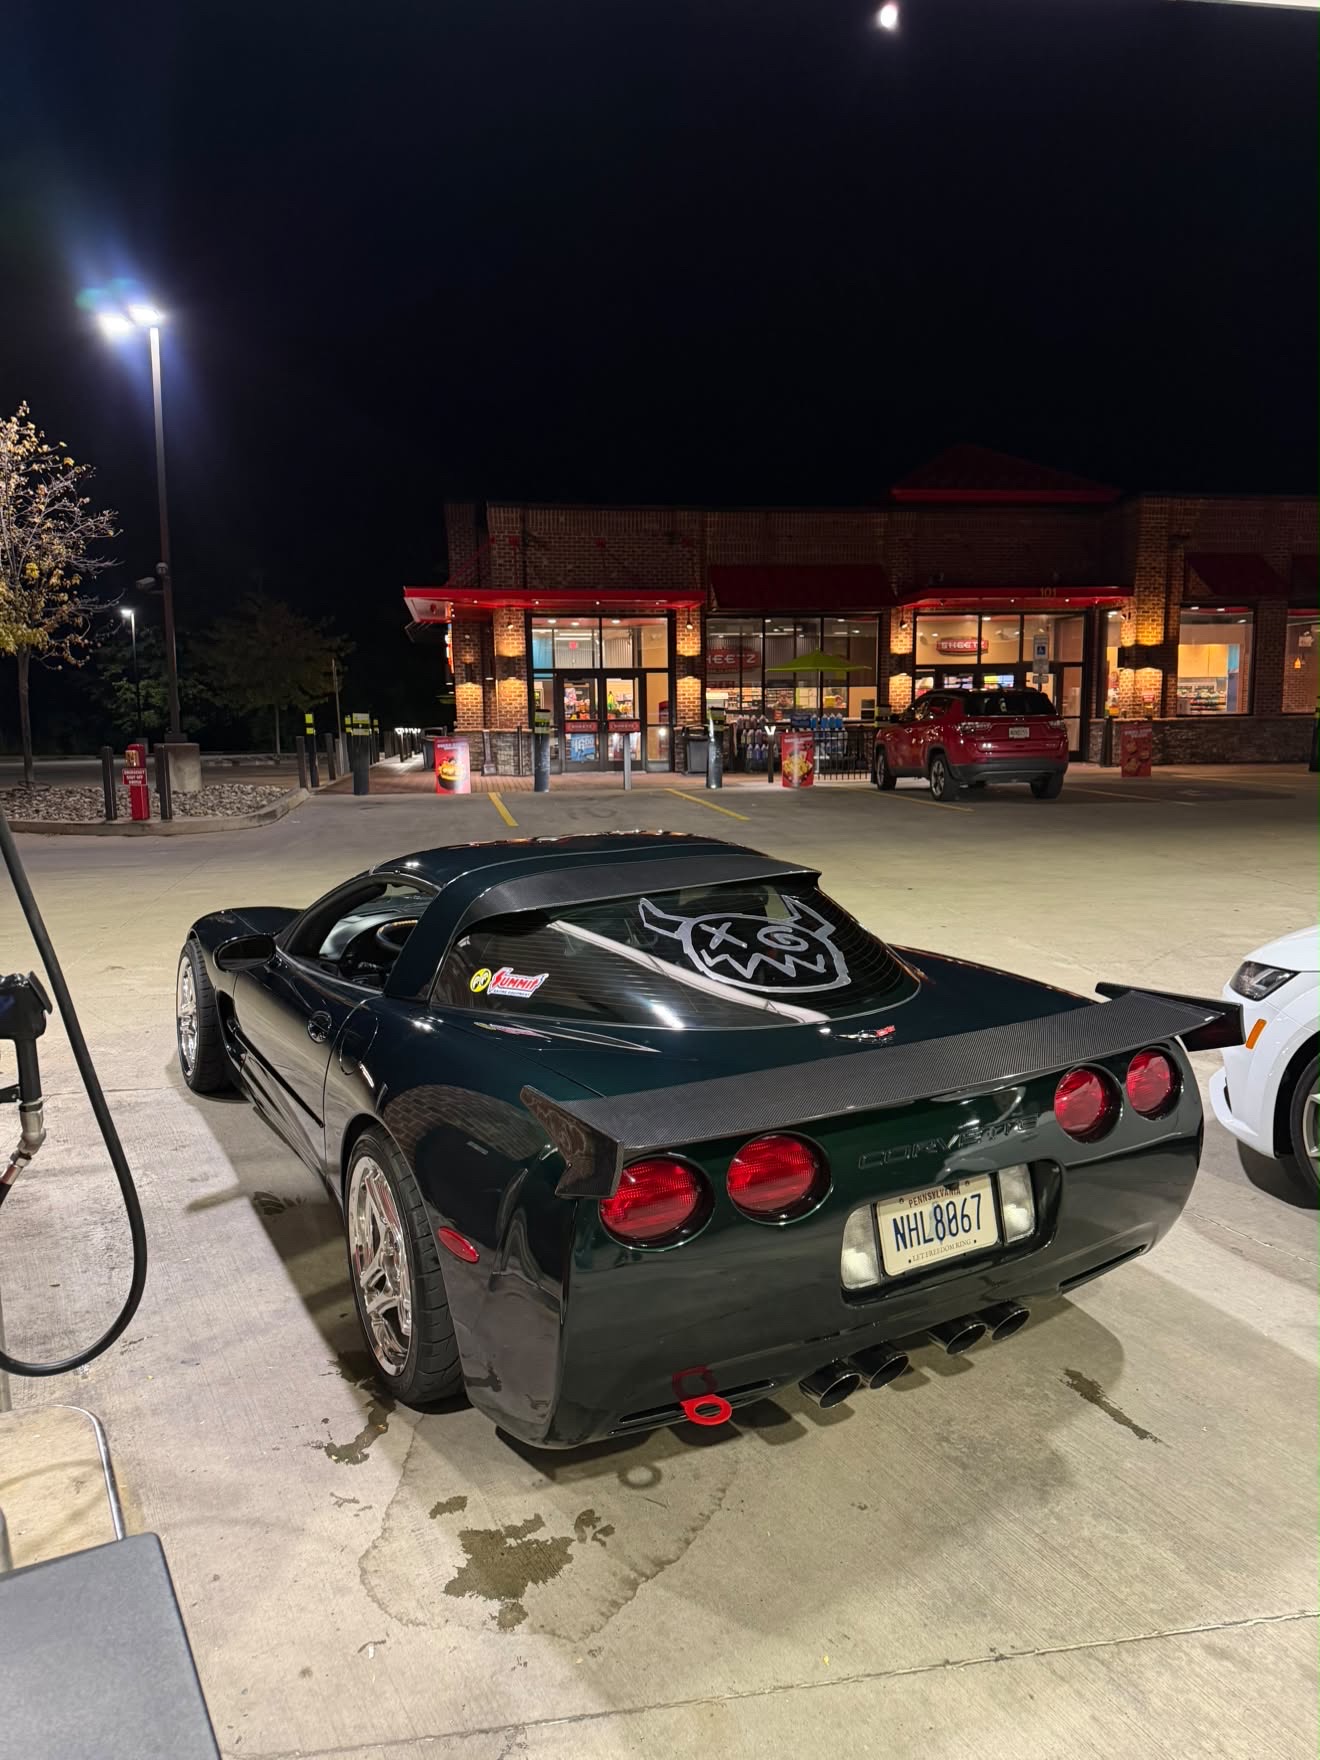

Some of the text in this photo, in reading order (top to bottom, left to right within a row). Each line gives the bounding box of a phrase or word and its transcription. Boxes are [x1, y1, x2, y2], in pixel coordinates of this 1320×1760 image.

[1040, 587, 1056, 597] 101
[492, 970, 539, 989] SUMMIT
[908, 1188, 961, 1208] PENNSYLVANIA
[892, 1193, 982, 1251] NHL8067
